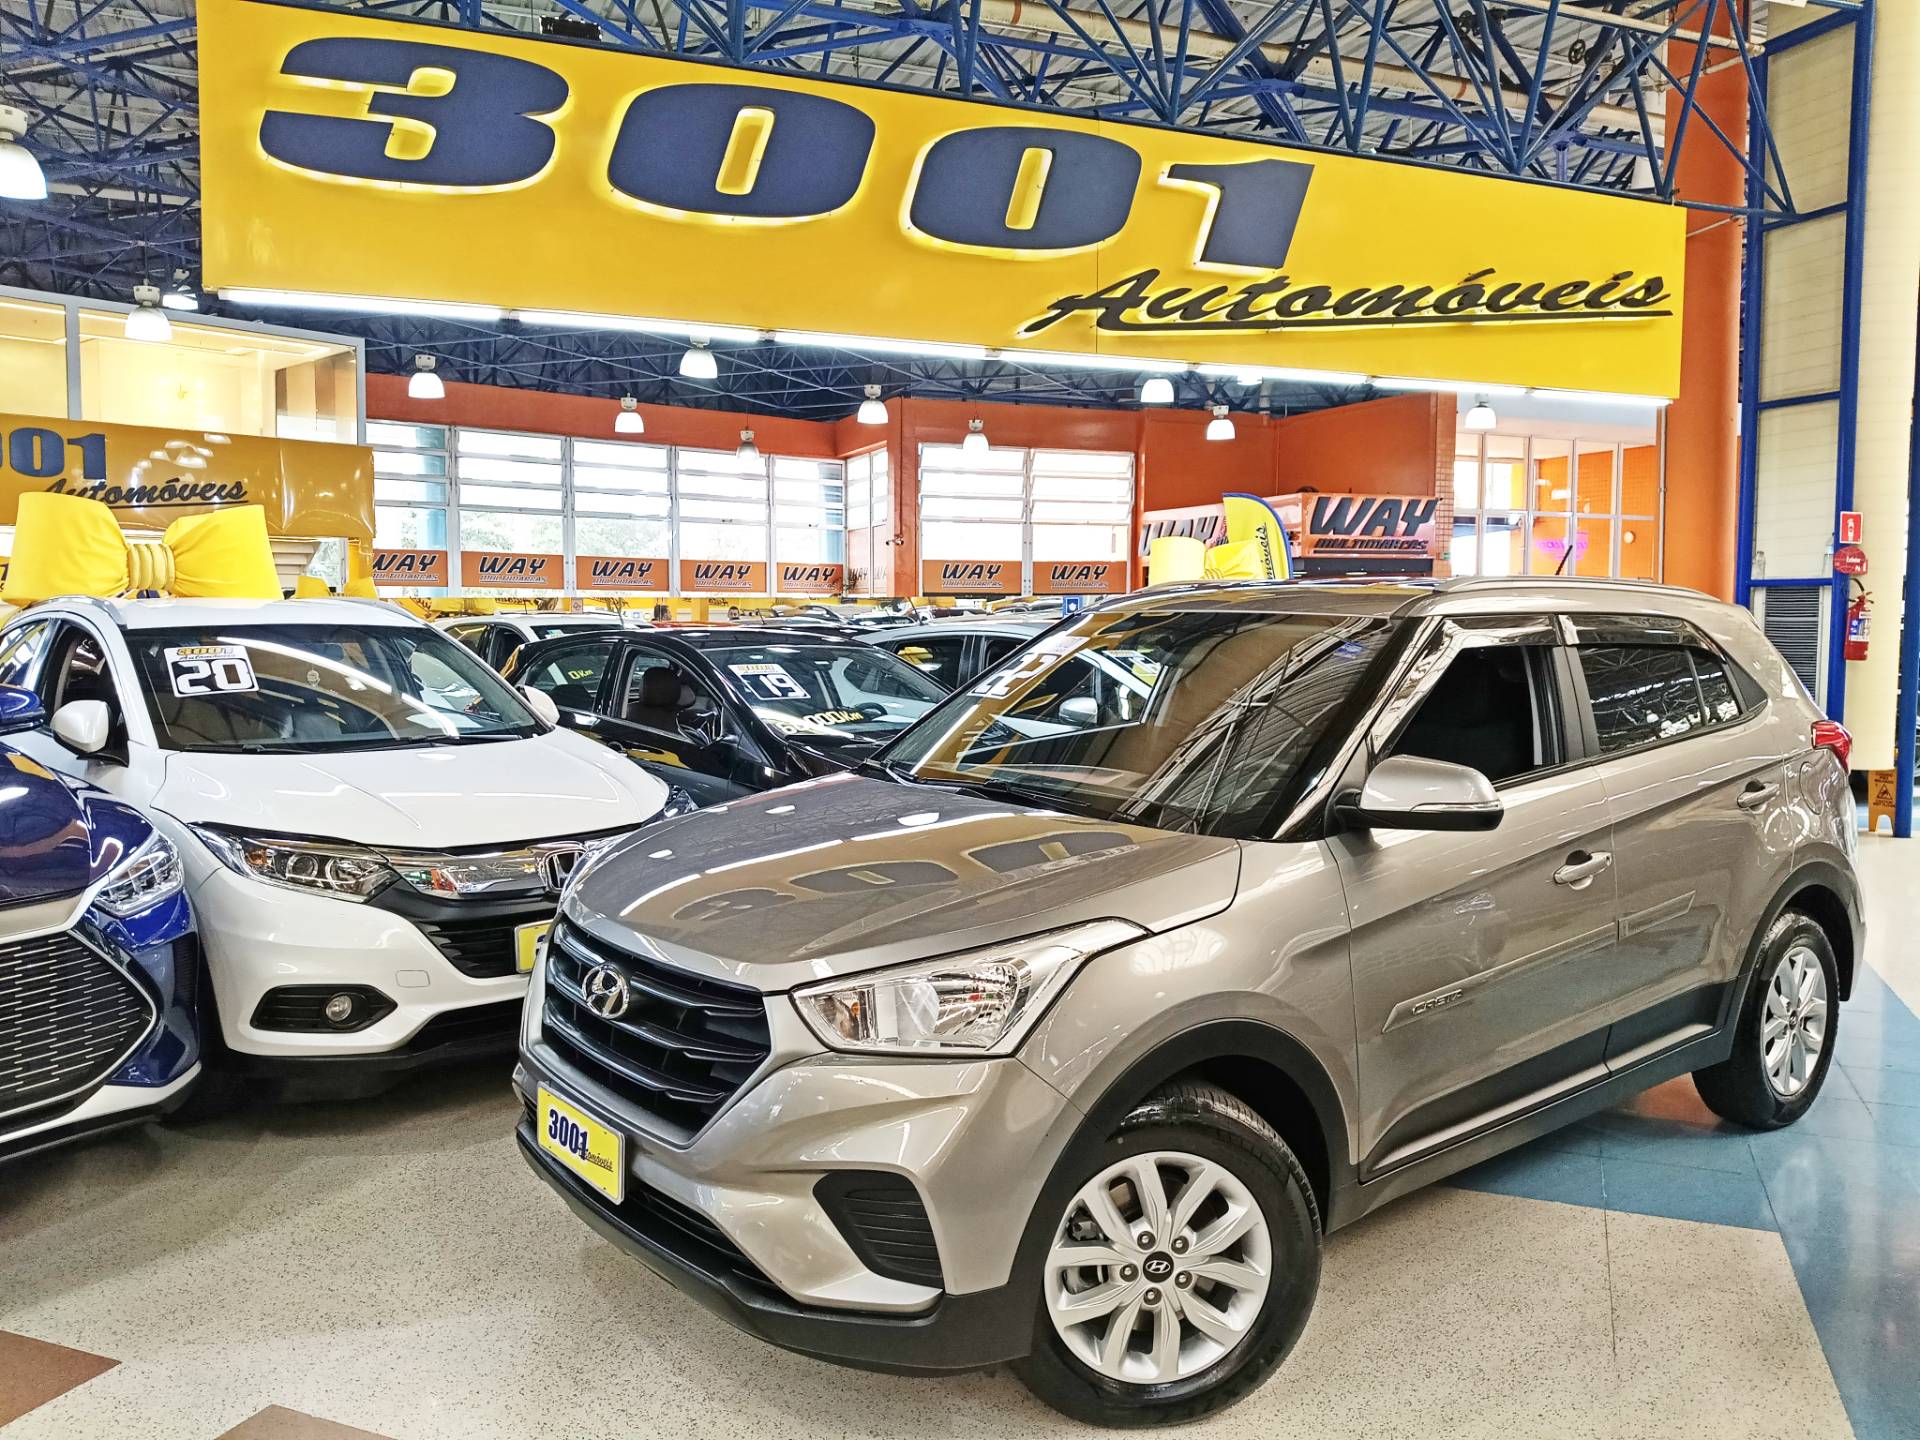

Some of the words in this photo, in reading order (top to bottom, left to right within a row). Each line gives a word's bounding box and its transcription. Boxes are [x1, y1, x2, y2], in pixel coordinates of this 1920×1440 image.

[259, 37, 1315, 270] 3001
[1023, 268, 1673, 332] Automóveis
[0, 427, 107, 480] 01
[1310, 496, 1439, 537] WAY
[479, 556, 546, 575] WAY
[592, 560, 653, 577] WAY
[695, 564, 752, 580] WAY
[783, 566, 835, 581] WAY
[942, 564, 1002, 579] WAY
[1051, 565, 1108, 580] WAY
[176, 660, 253, 693] 20
[759, 674, 805, 697] 19
[548, 1108, 588, 1161] 3001
